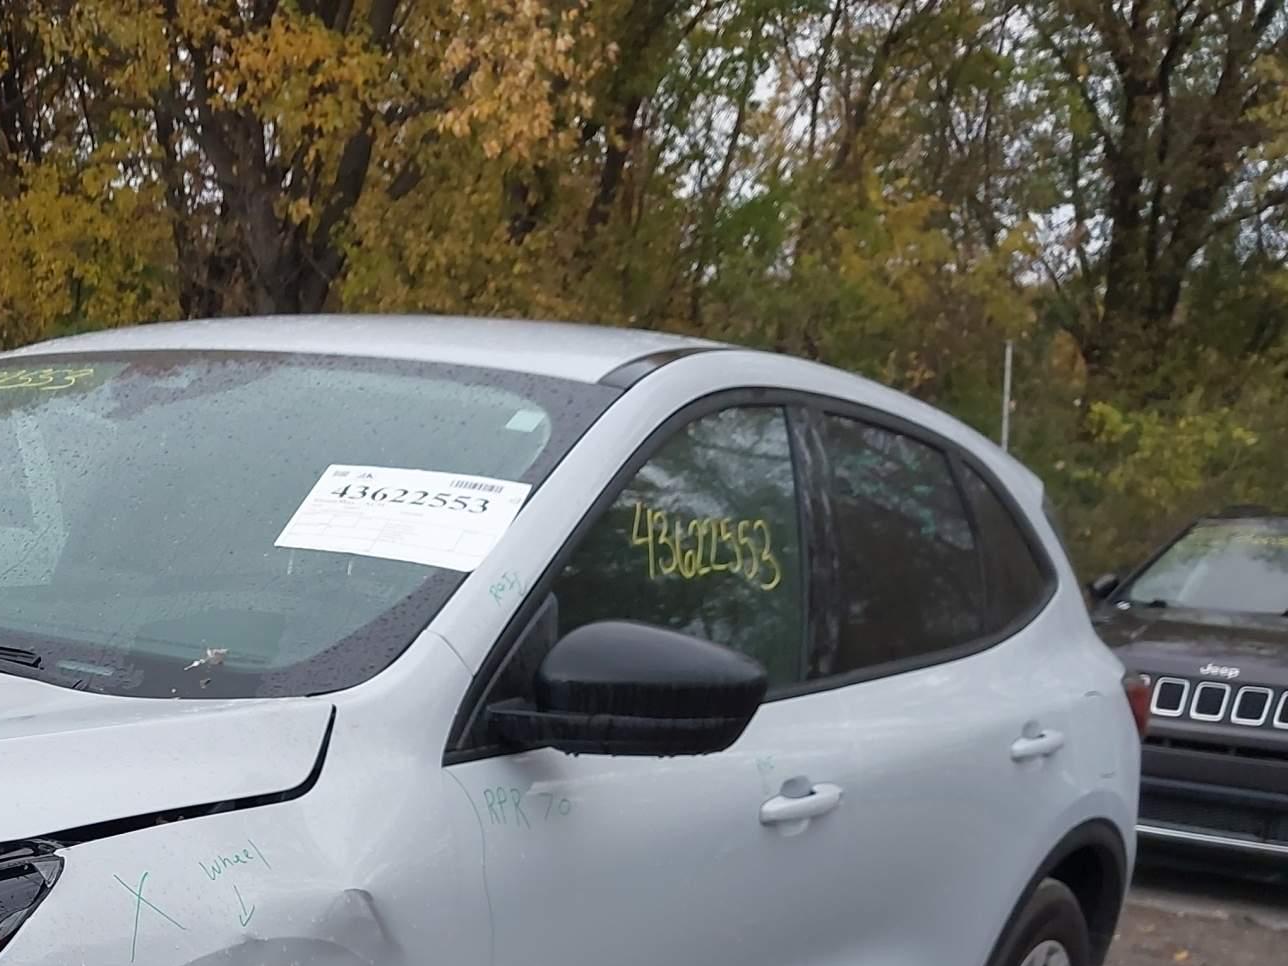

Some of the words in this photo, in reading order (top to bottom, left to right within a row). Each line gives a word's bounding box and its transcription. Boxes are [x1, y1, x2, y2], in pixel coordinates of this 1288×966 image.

[330, 483, 490, 515] 43622553
[631, 500, 782, 592] 43622553
[1199, 662, 1241, 679] Jeep
